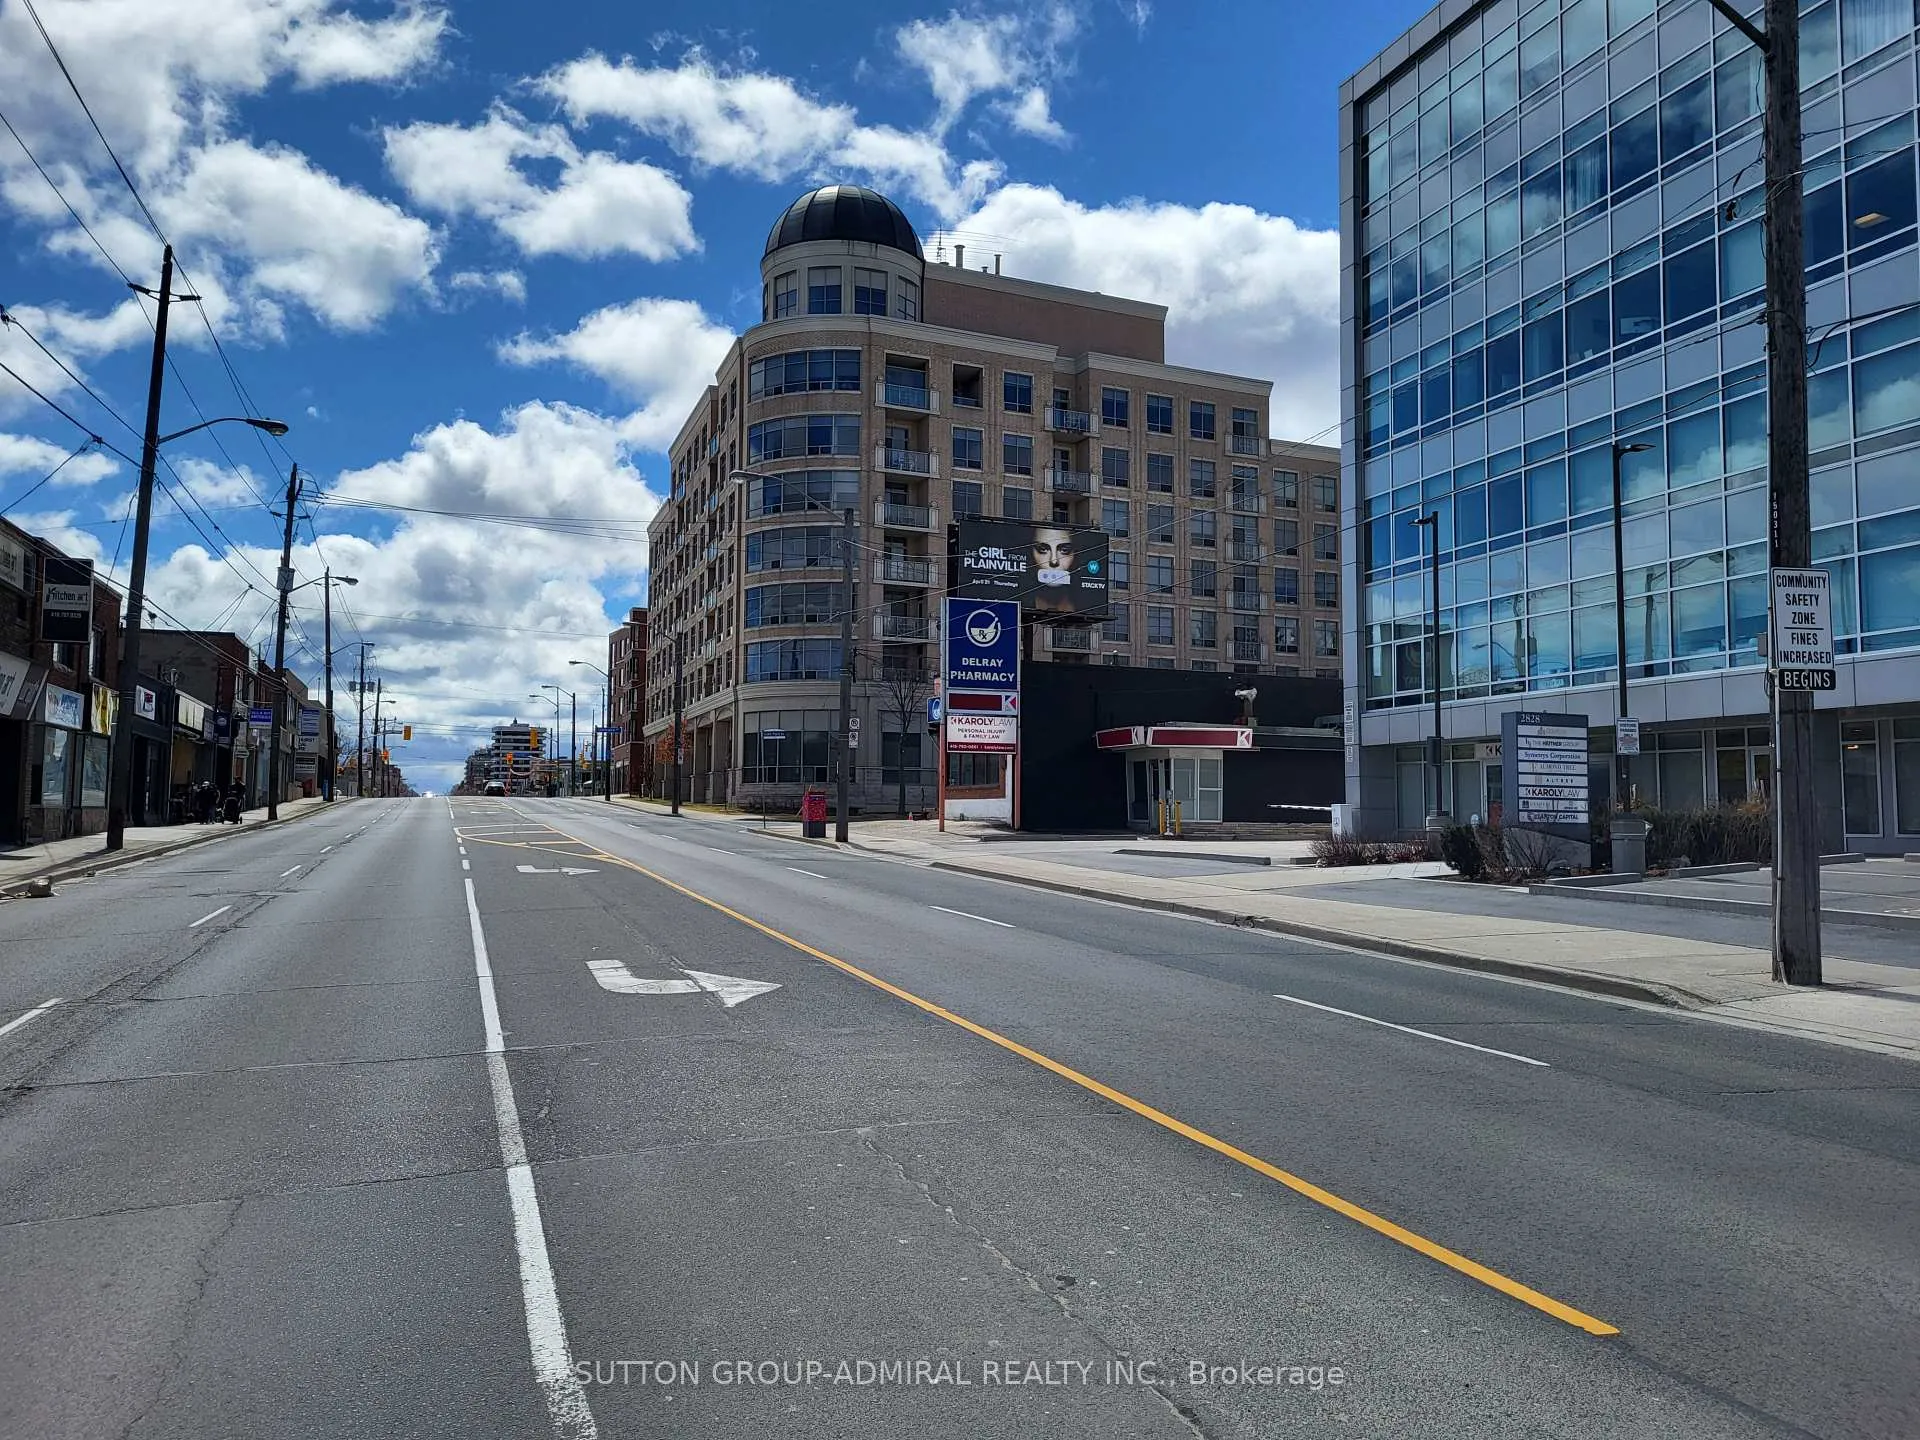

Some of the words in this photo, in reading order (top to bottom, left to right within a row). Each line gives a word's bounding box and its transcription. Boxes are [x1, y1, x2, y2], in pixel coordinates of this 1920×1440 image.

[965, 549, 978, 557] THE
[979, 546, 1007, 560] GIRL
[1008, 553, 1027, 561] FROM
[964, 557, 1027, 572] PLAINVILLE
[1776, 574, 1826, 589] COMMUNITY
[1785, 593, 1820, 607] SAFETY
[1791, 612, 1816, 625] ZONE
[1791, 632, 1818, 646] FINES
[962, 657, 1004, 667] DELRAY
[1780, 650, 1832, 664] INCREASED
[950, 670, 1015, 682] PHARMACY
[1784, 671, 1831, 688] BEGINS
[1520, 713, 1541, 723] 2828
